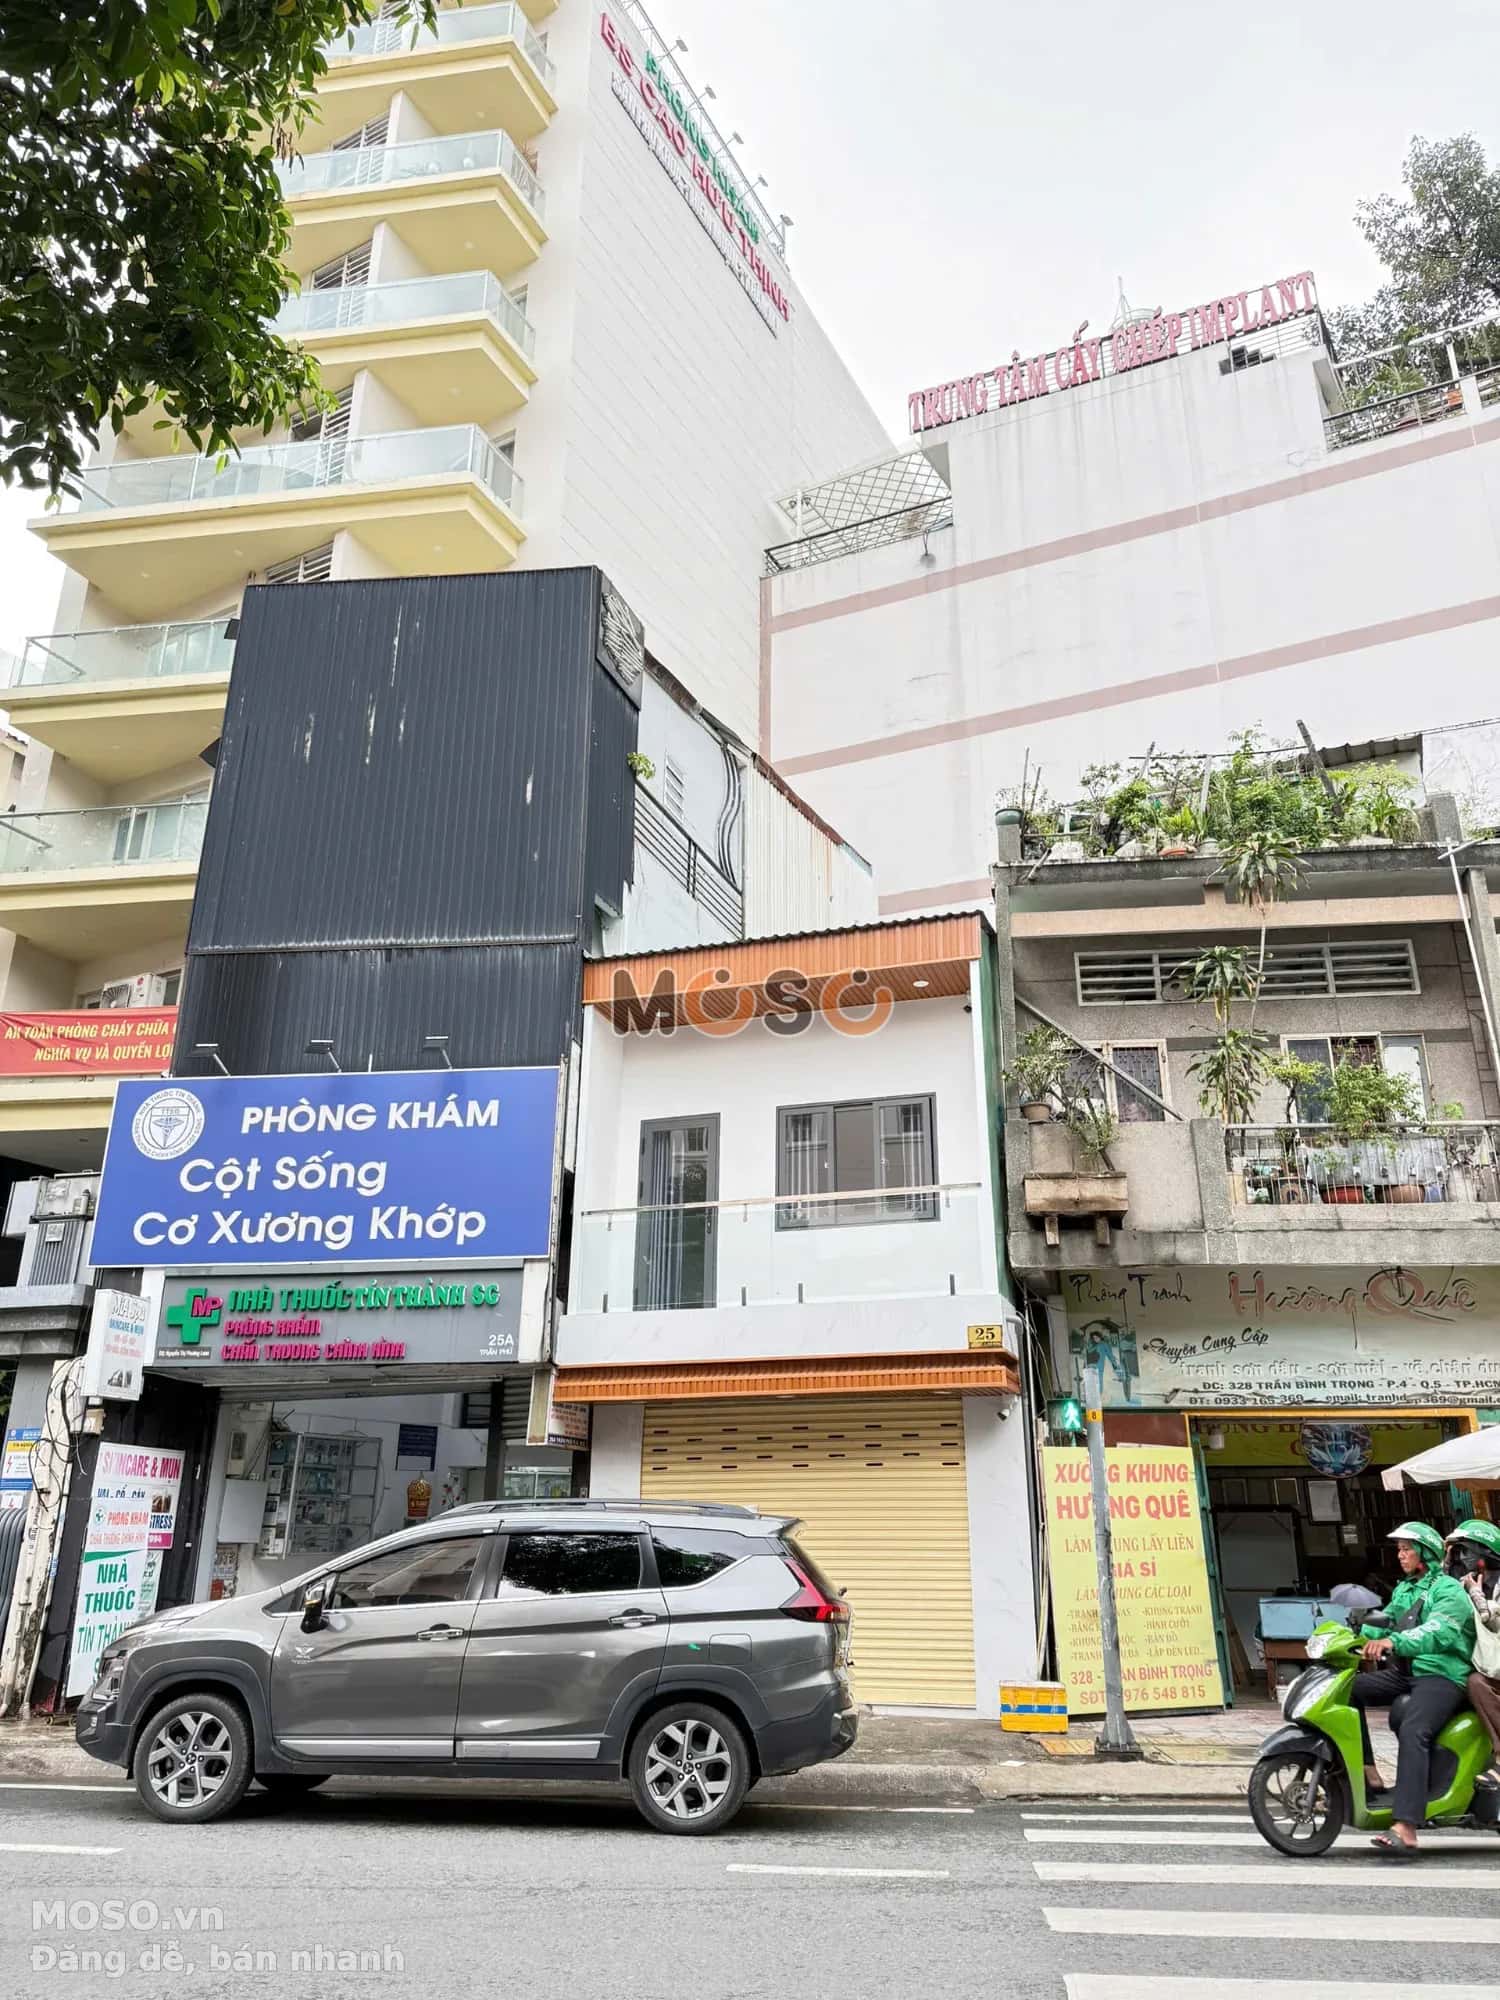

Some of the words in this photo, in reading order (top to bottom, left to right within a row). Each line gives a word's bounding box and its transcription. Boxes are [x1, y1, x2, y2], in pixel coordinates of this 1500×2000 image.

[640, 75, 685, 158] CAO
[908, 372, 988, 431] TRUNG
[994, 349, 1050, 403] TÂM
[1054, 319, 1101, 390] CẤY
[1186, 270, 1313, 350] IMPLANT
[57, 1022, 98, 1038] PHÒNG
[101, 1019, 134, 1037] CHÁY
[136, 1018, 169, 1035] CHỮA
[34, 1044, 71, 1061] NGHĨA
[75, 1047, 92, 1063] VỤ
[95, 1042, 109, 1060] VÀ
[241, 1098, 376, 1134] PHÒNG
[388, 1093, 500, 1130] KHÁM
[179, 1156, 262, 1199] Cột
[272, 1150, 387, 1197] Sống
[133, 1211, 198, 1246] Cơ
[208, 1210, 354, 1250] Xương
[369, 1201, 487, 1245] Khớp
[228, 1284, 274, 1312] NHÀ
[280, 1280, 353, 1312] THUỐC
[354, 1279, 391, 1310] TÍN
[392, 1276, 467, 1309] THÀNH
[489, 1334, 514, 1347] 25A
[975, 1327, 995, 1340] 25
[1201, 1334, 1236, 1353] Cung
[1241, 1327, 1269, 1345] Cấp
[1228, 1382, 1253, 1390] 328
[1296, 1379, 1326, 1389] BÌNH
[1331, 1380, 1375, 1390] TRỌNG
[1387, 1380, 1407, 1388] P.4
[1420, 1380, 1442, 1389] Q.5
[150, 1457, 158, 1478] &
[159, 1457, 182, 1484] MỤN
[1126, 1463, 1189, 1483] KHUNG
[1056, 1492, 1141, 1520] HƯNG
[1145, 1489, 1192, 1520] QUÊ
[97, 1559, 128, 1584] NHÀ
[85, 1584, 136, 1614] THUỐC
[78, 1618, 97, 1654] TÍN
[1071, 1671, 1093, 1685] 328
[1140, 1664, 1168, 1681] BÌNH
[1171, 1663, 1213, 1680] TRỌNG
[1153, 1687, 1178, 1700] 548
[1181, 1685, 1206, 1699] 815
